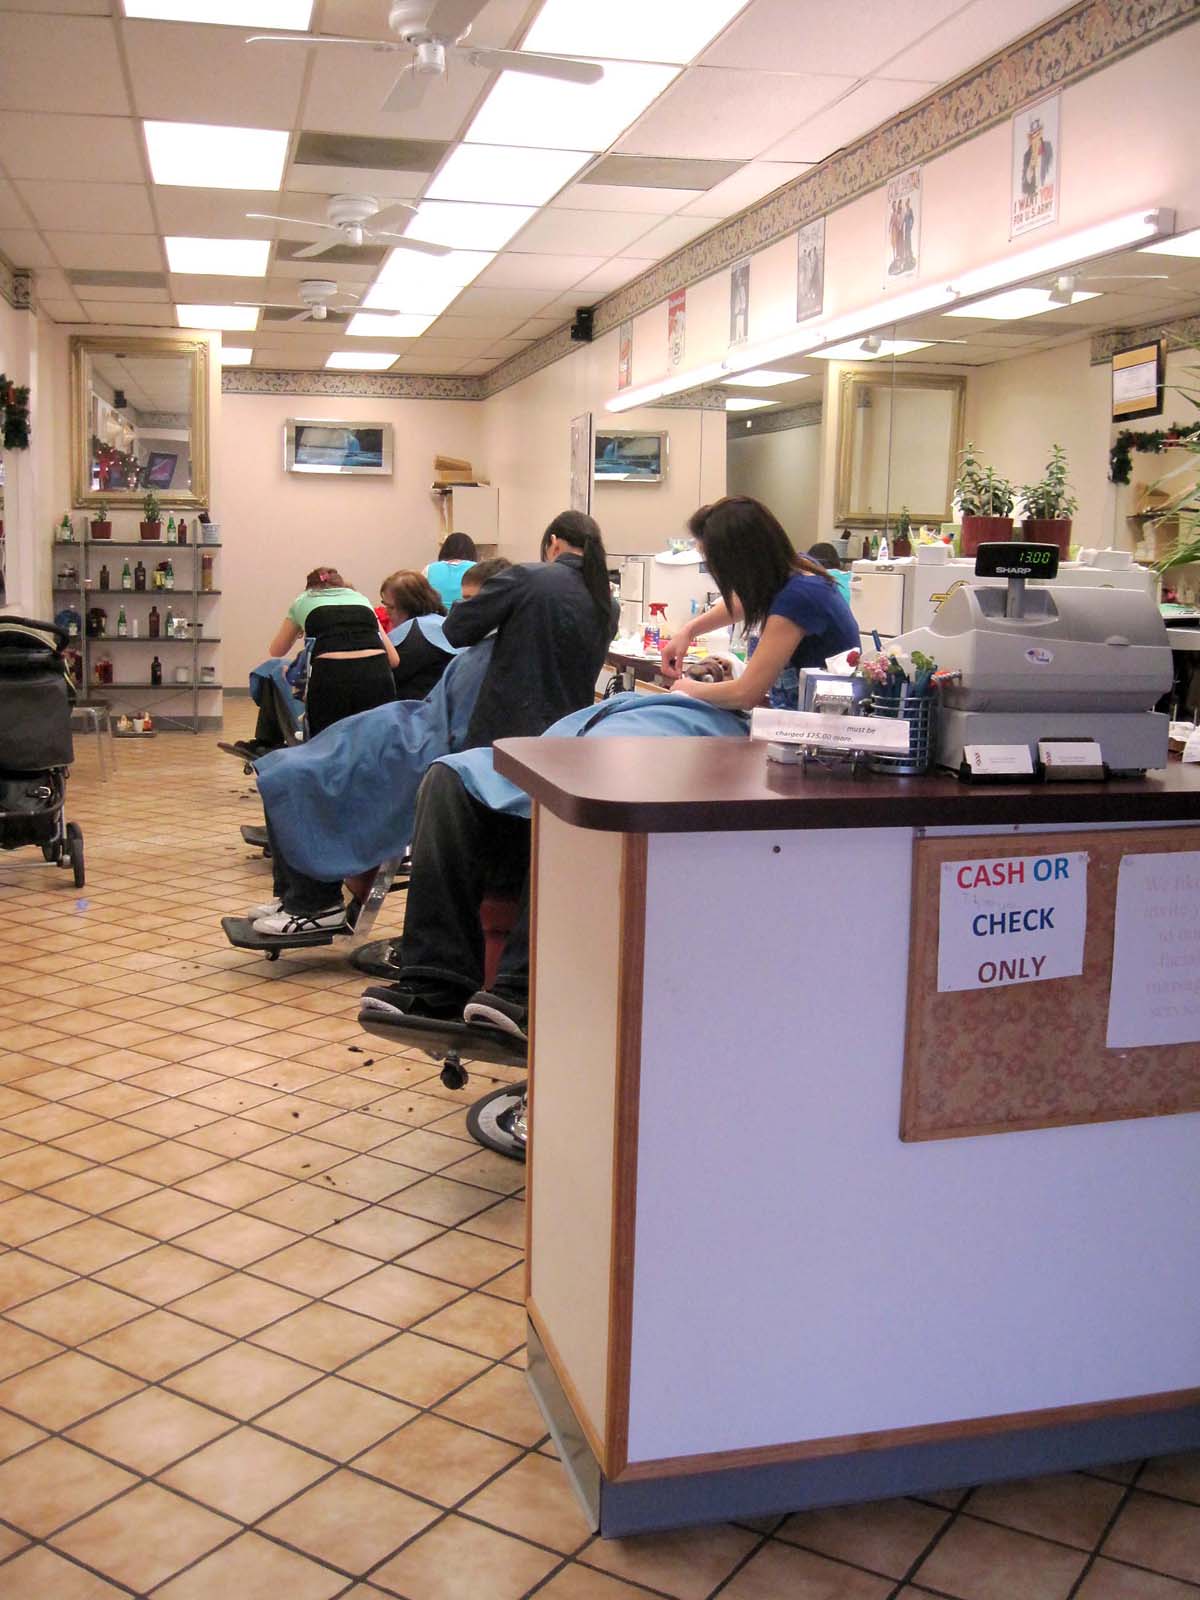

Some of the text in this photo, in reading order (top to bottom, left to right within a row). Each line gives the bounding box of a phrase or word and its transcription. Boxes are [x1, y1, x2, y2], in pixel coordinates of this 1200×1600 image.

[995, 566, 1032, 574] SHARP
[775, 730, 805, 738] charged
[957, 857, 1070, 889] CASH OR
[972, 907, 1055, 937] CHECK
[978, 955, 1047, 983] ONLY
